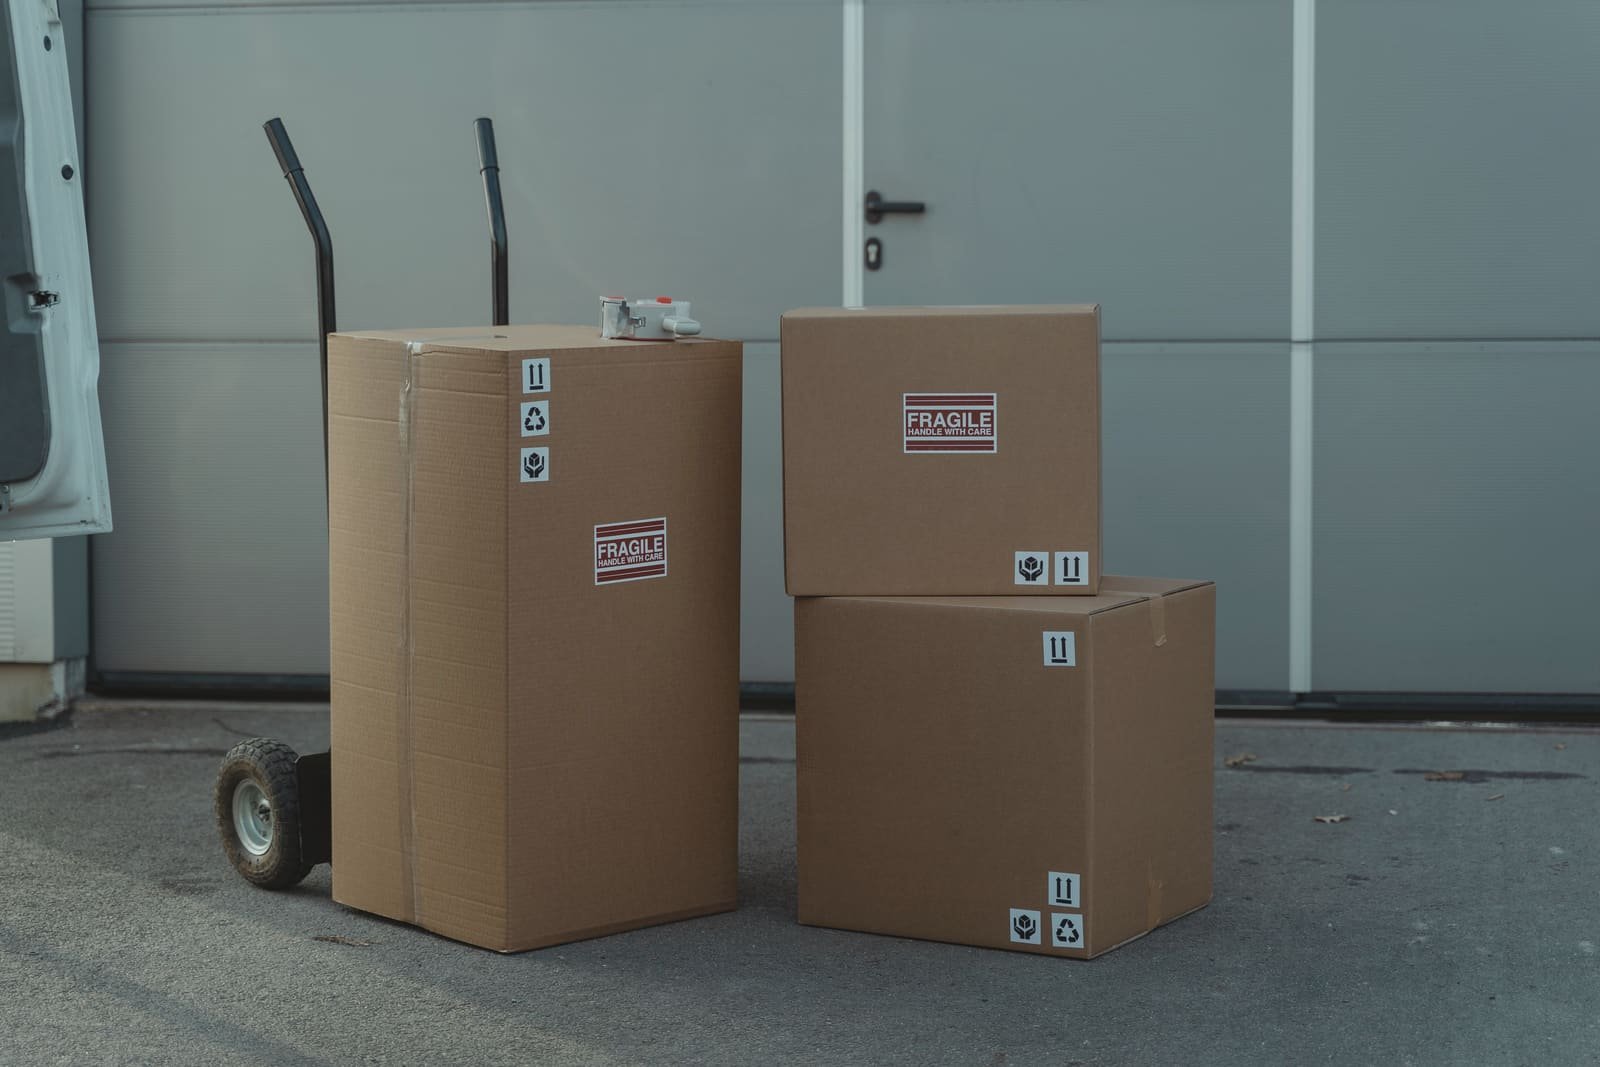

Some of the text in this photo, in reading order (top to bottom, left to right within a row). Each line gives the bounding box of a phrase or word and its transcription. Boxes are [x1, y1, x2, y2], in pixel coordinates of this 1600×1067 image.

[907, 412, 991, 427] FRAGILE
[597, 537, 663, 559] FRAGILE
[598, 552, 663, 567] HANDLE WITH CARE
